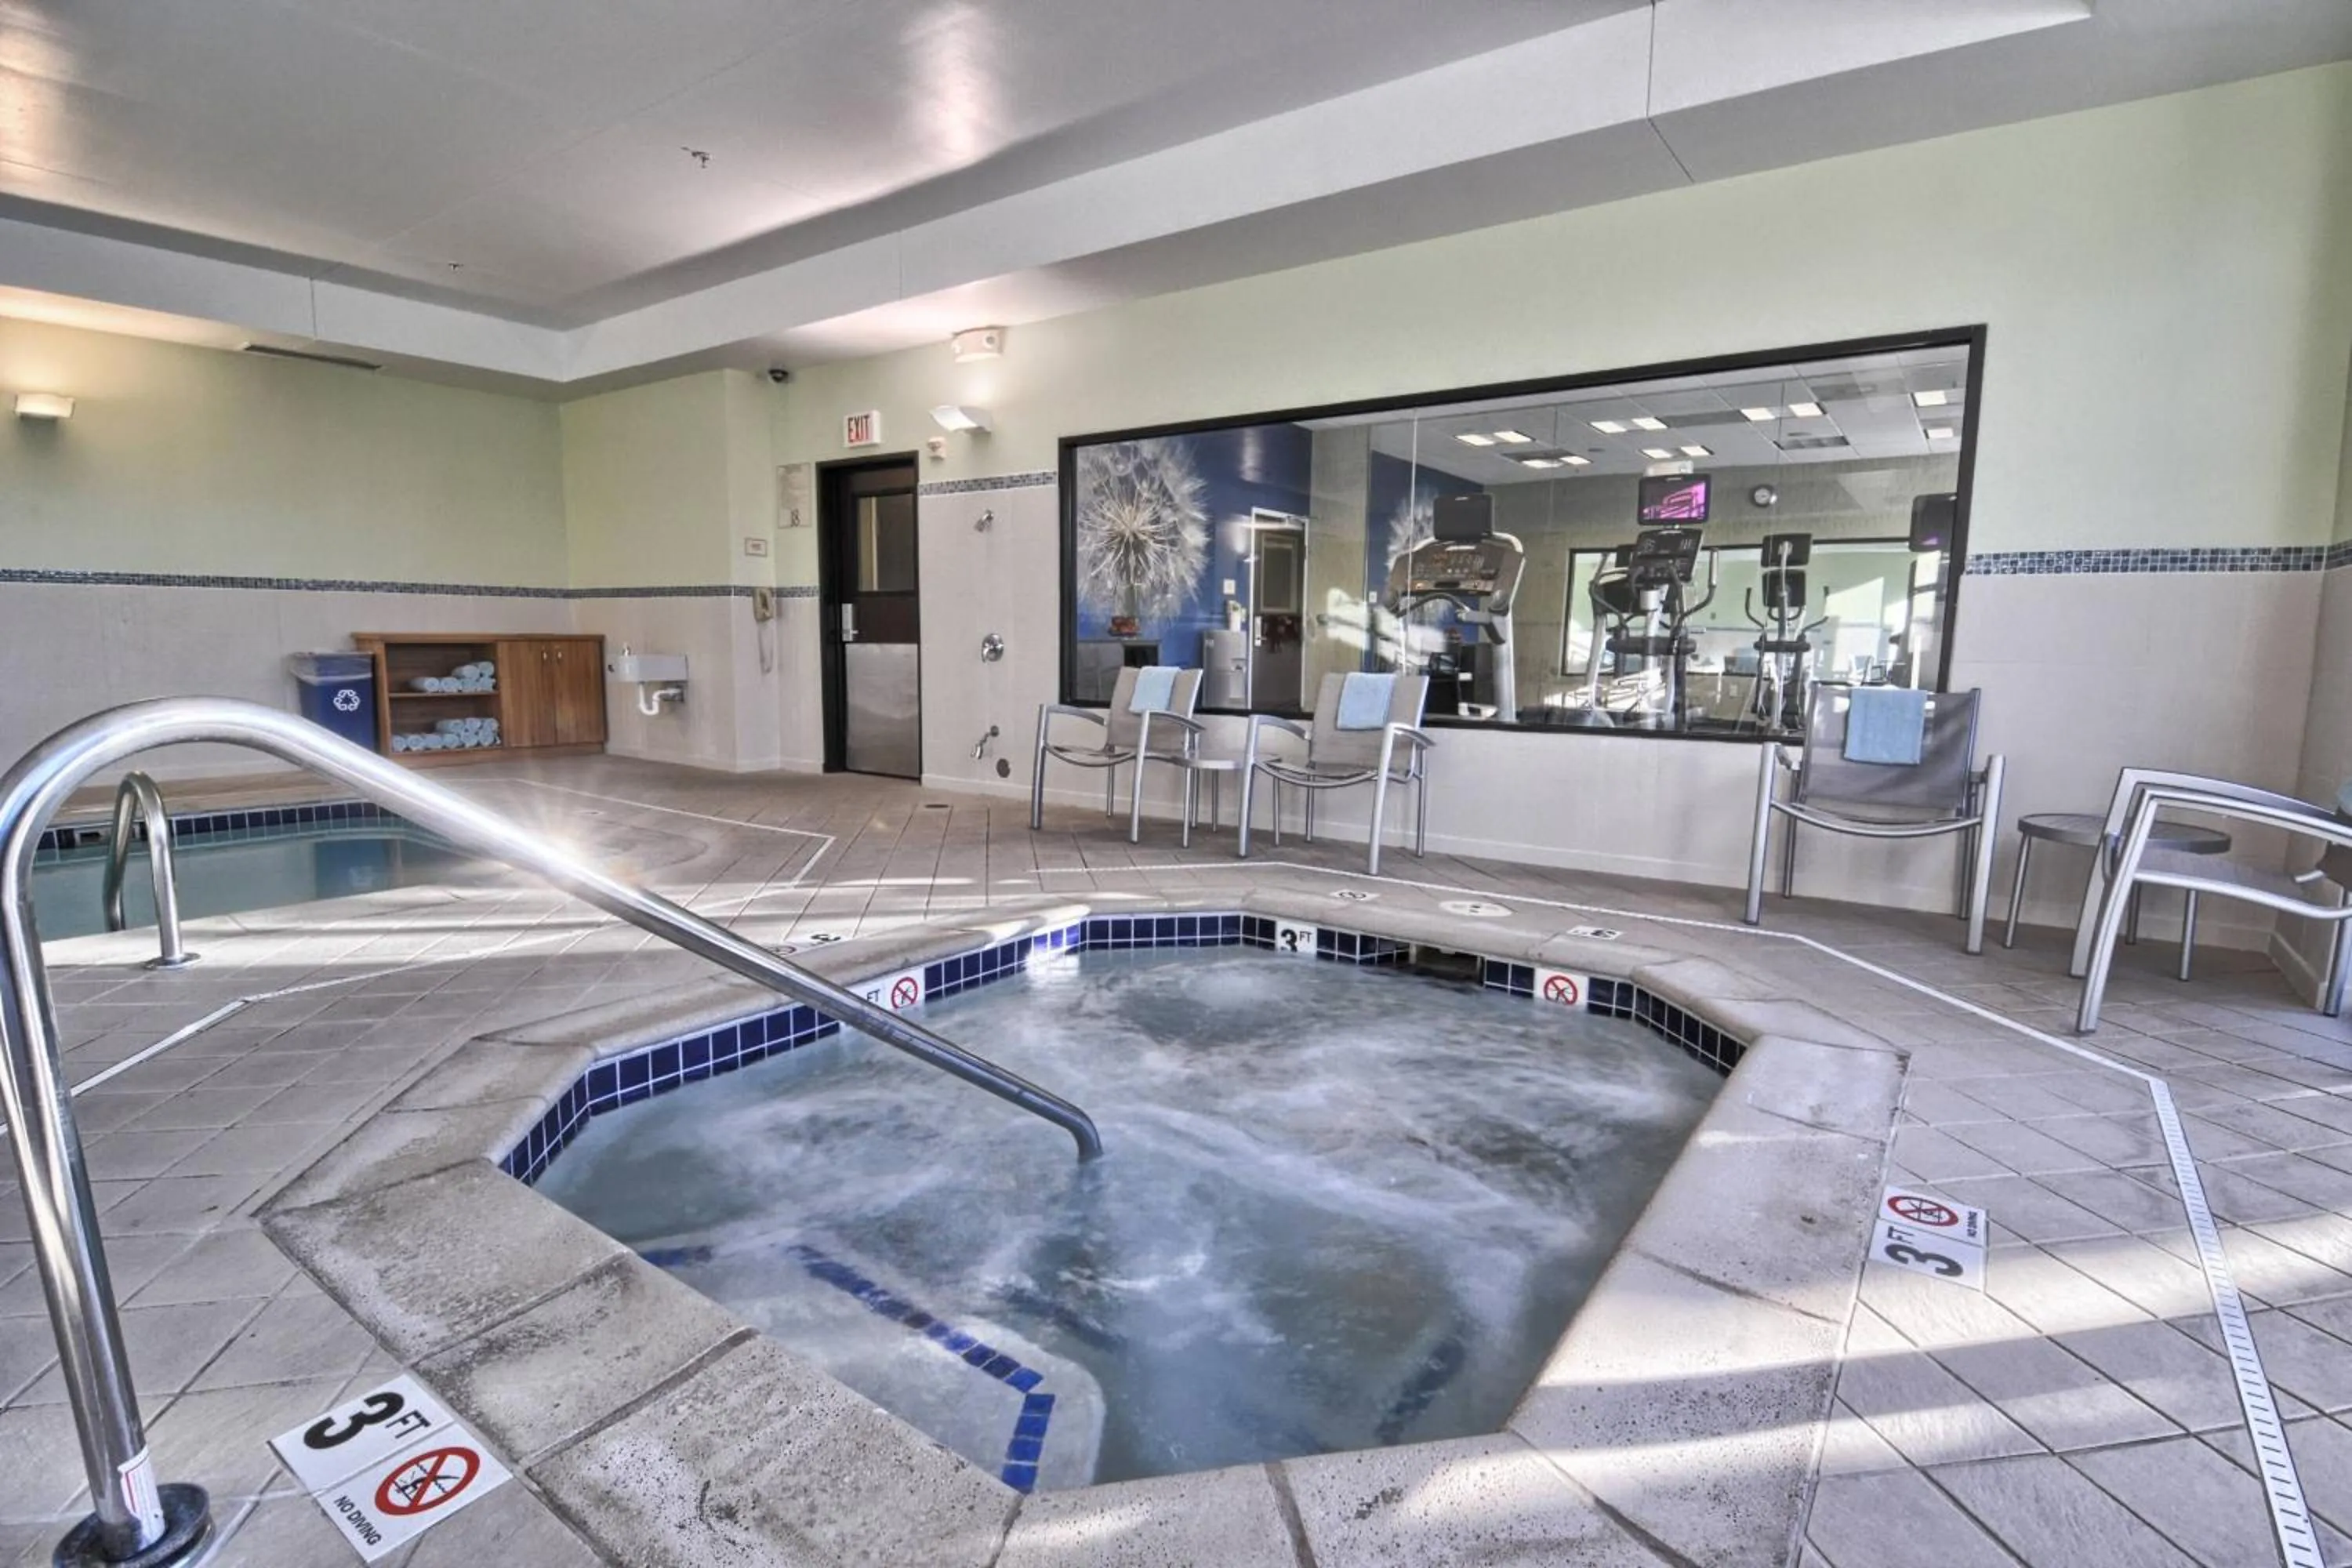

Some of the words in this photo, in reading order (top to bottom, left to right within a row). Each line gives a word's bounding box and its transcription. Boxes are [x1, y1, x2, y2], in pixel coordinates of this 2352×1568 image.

[848, 415, 870, 443] EXIT
[1280, 928, 1298, 953] 3
[1299, 931, 1313, 944] FT
[866, 989, 880, 1003] FT
[1887, 1225, 1915, 1245] FT
[1884, 1243, 1964, 1277] 3
[303, 1392, 405, 1450] 3
[385, 1410, 431, 1439] FT
[333, 1495, 354, 1513] NO
[347, 1510, 382, 1545] DIVING
